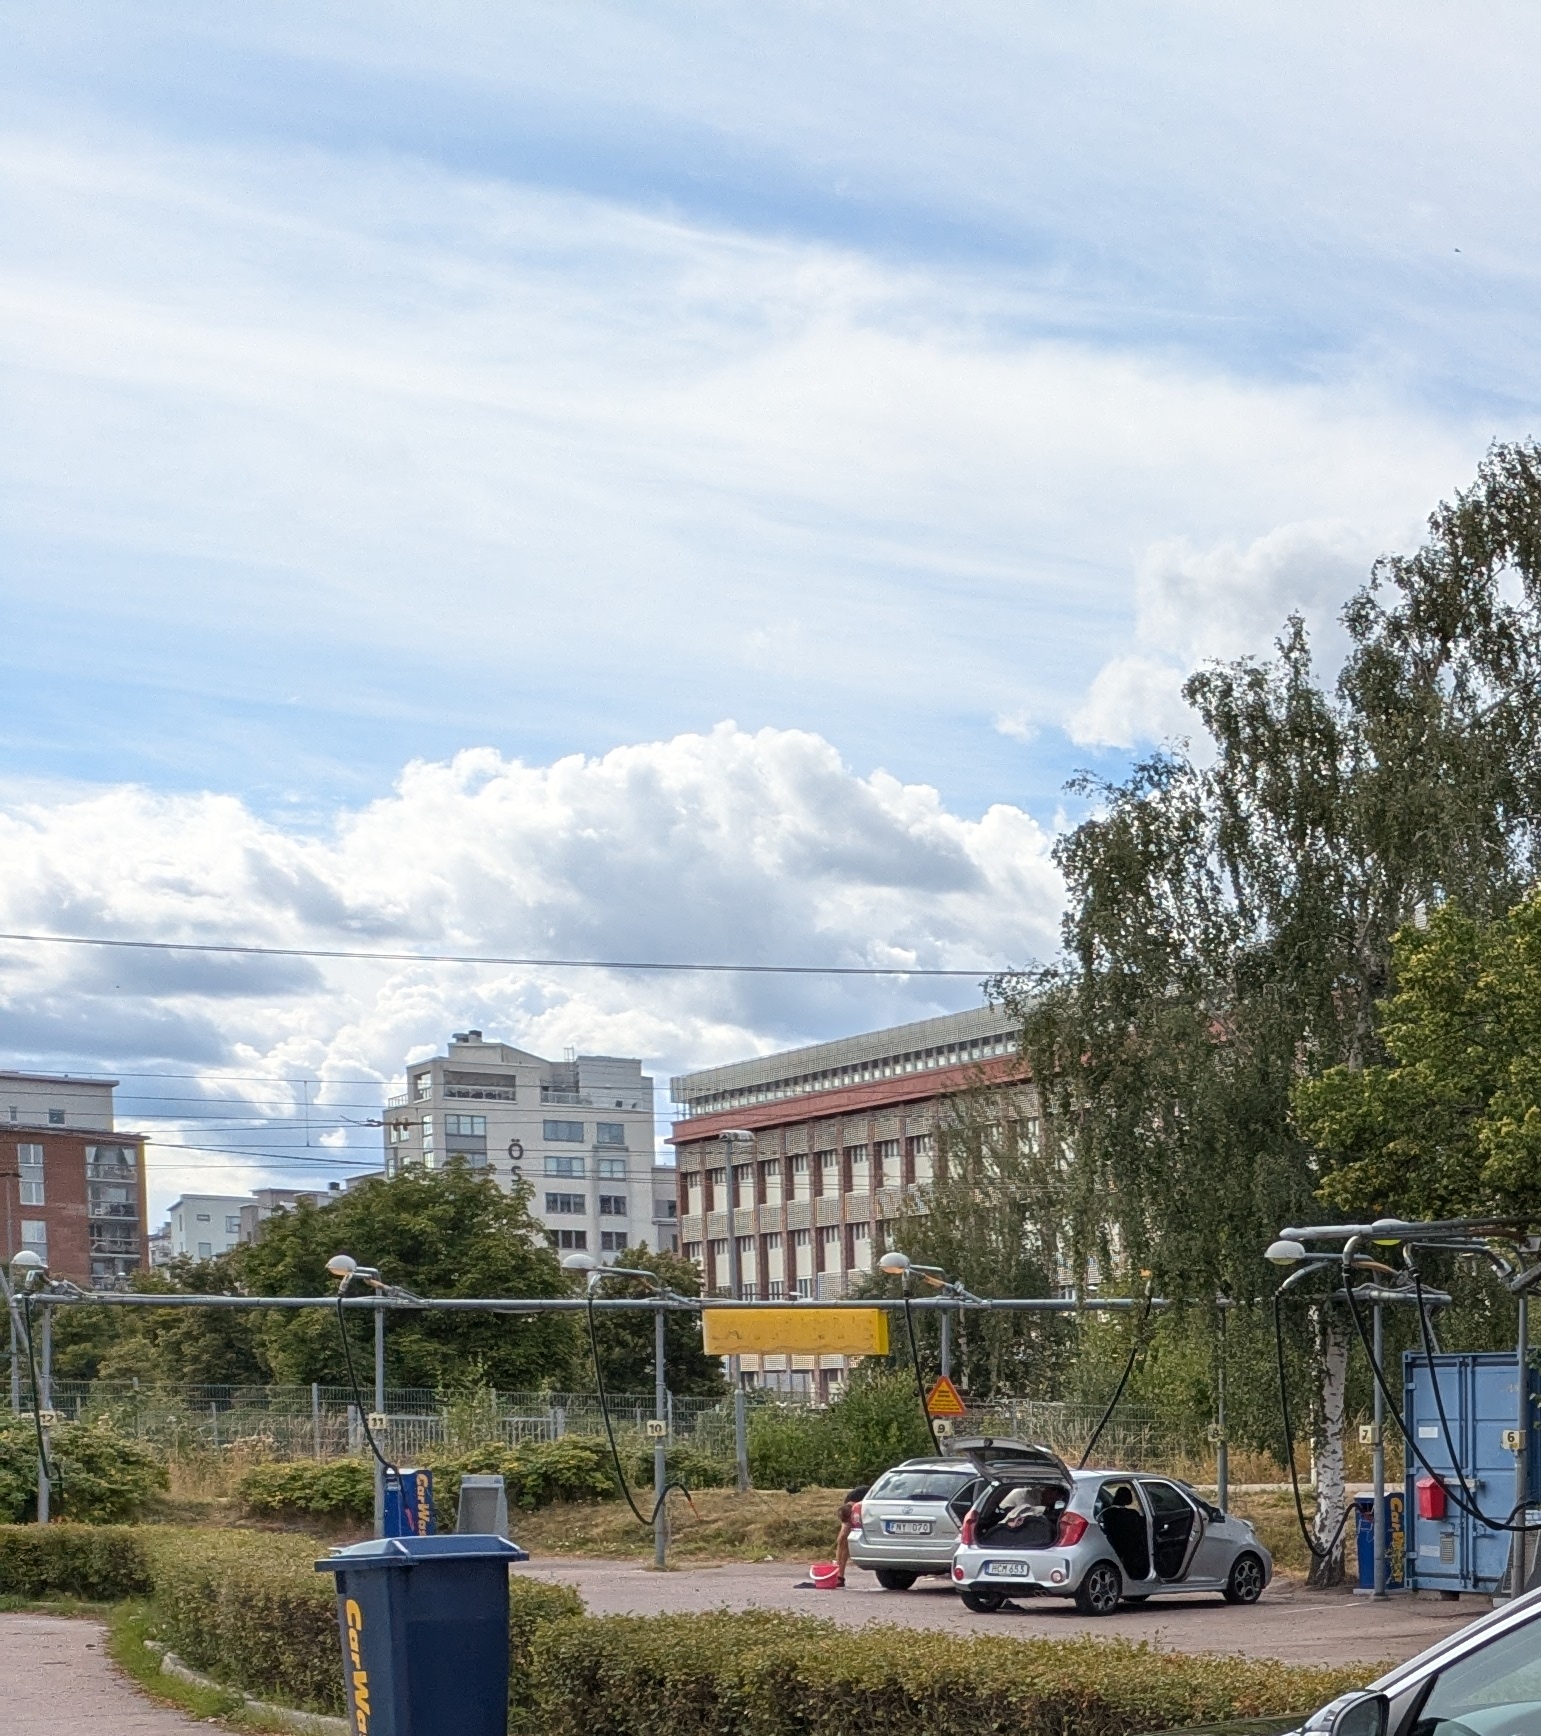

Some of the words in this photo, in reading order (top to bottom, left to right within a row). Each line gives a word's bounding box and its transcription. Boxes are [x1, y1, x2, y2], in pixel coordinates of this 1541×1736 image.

[649, 1424, 662, 1433] 10
[937, 1424, 946, 1434] 9
[1362, 1429, 1369, 1441] 7
[1507, 1431, 1515, 1443] 6
[416, 1473, 430, 1536] CarWas
[1390, 1497, 1404, 1583] CarWh
